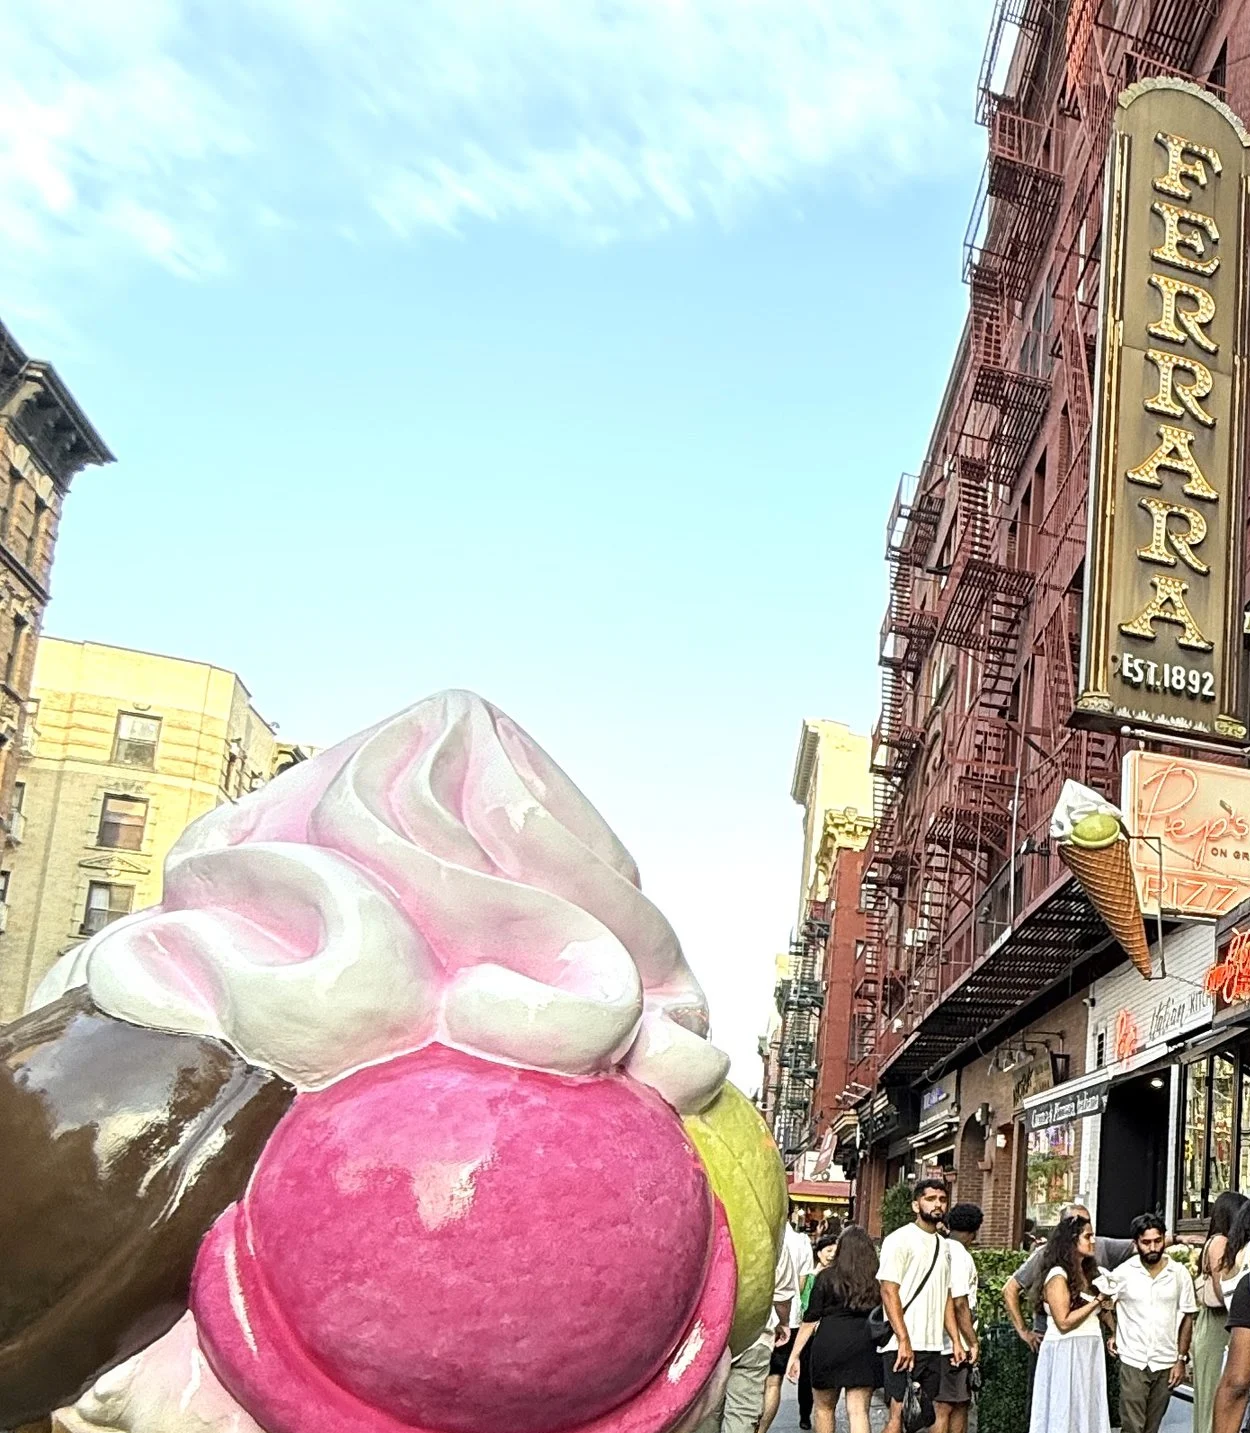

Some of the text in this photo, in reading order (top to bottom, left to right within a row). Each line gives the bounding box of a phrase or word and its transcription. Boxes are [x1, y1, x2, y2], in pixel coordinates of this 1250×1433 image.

[1119, 131, 1223, 650] FERRARA
[1138, 762, 1250, 871] Pep's
[1210, 847, 1228, 858] ON
[1143, 874, 1240, 912] PIZZ
